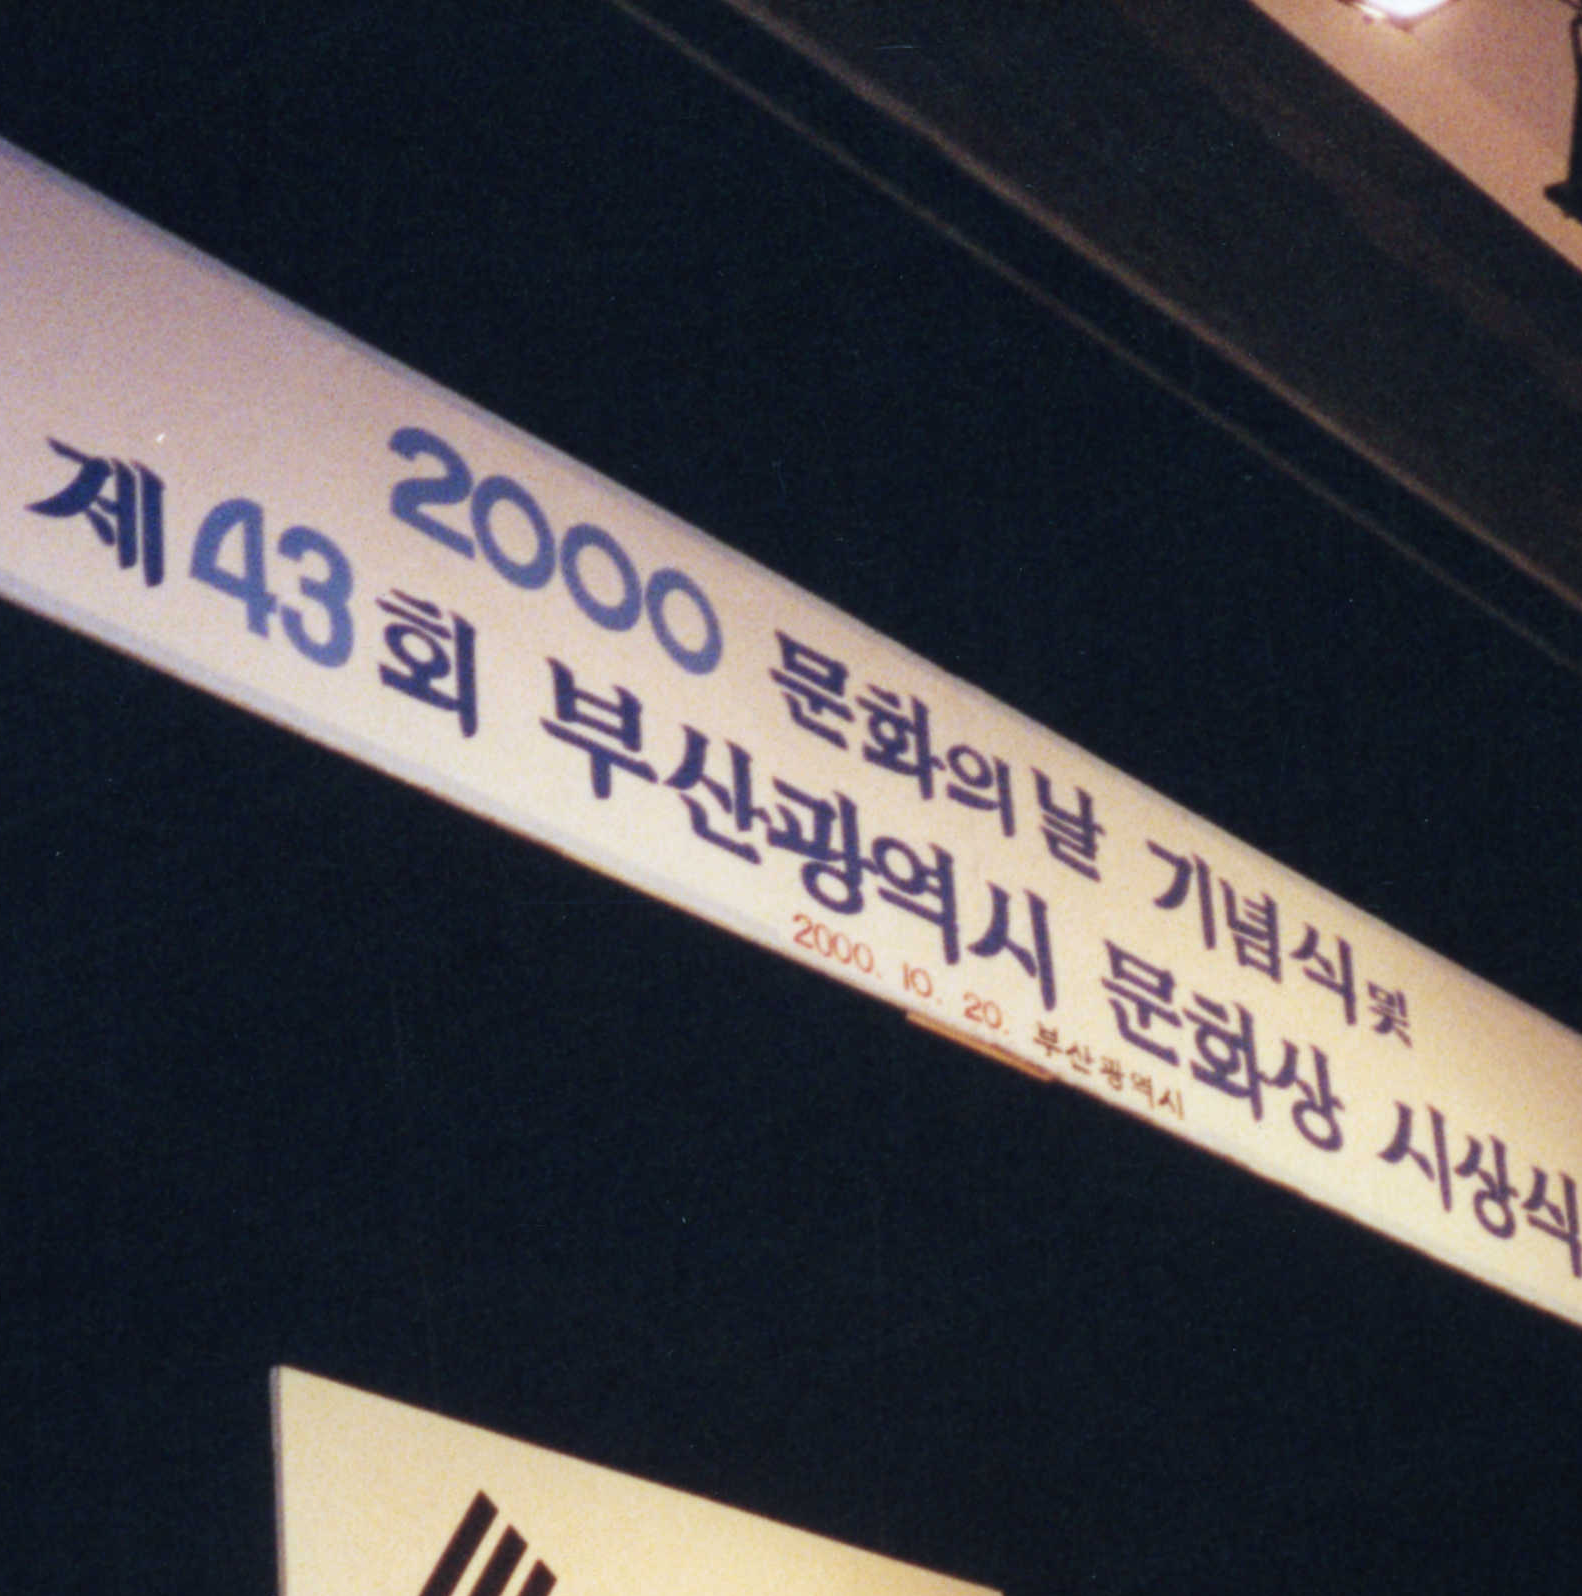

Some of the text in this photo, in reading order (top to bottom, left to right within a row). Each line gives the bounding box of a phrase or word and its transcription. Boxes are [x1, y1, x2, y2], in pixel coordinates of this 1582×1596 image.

[387, 427, 723, 674] 2000
[25, 437, 1582, 1278] 제43회 부산광역시 문화상 시상식
[1032, 1020, 1185, 1120] 부산광역시
